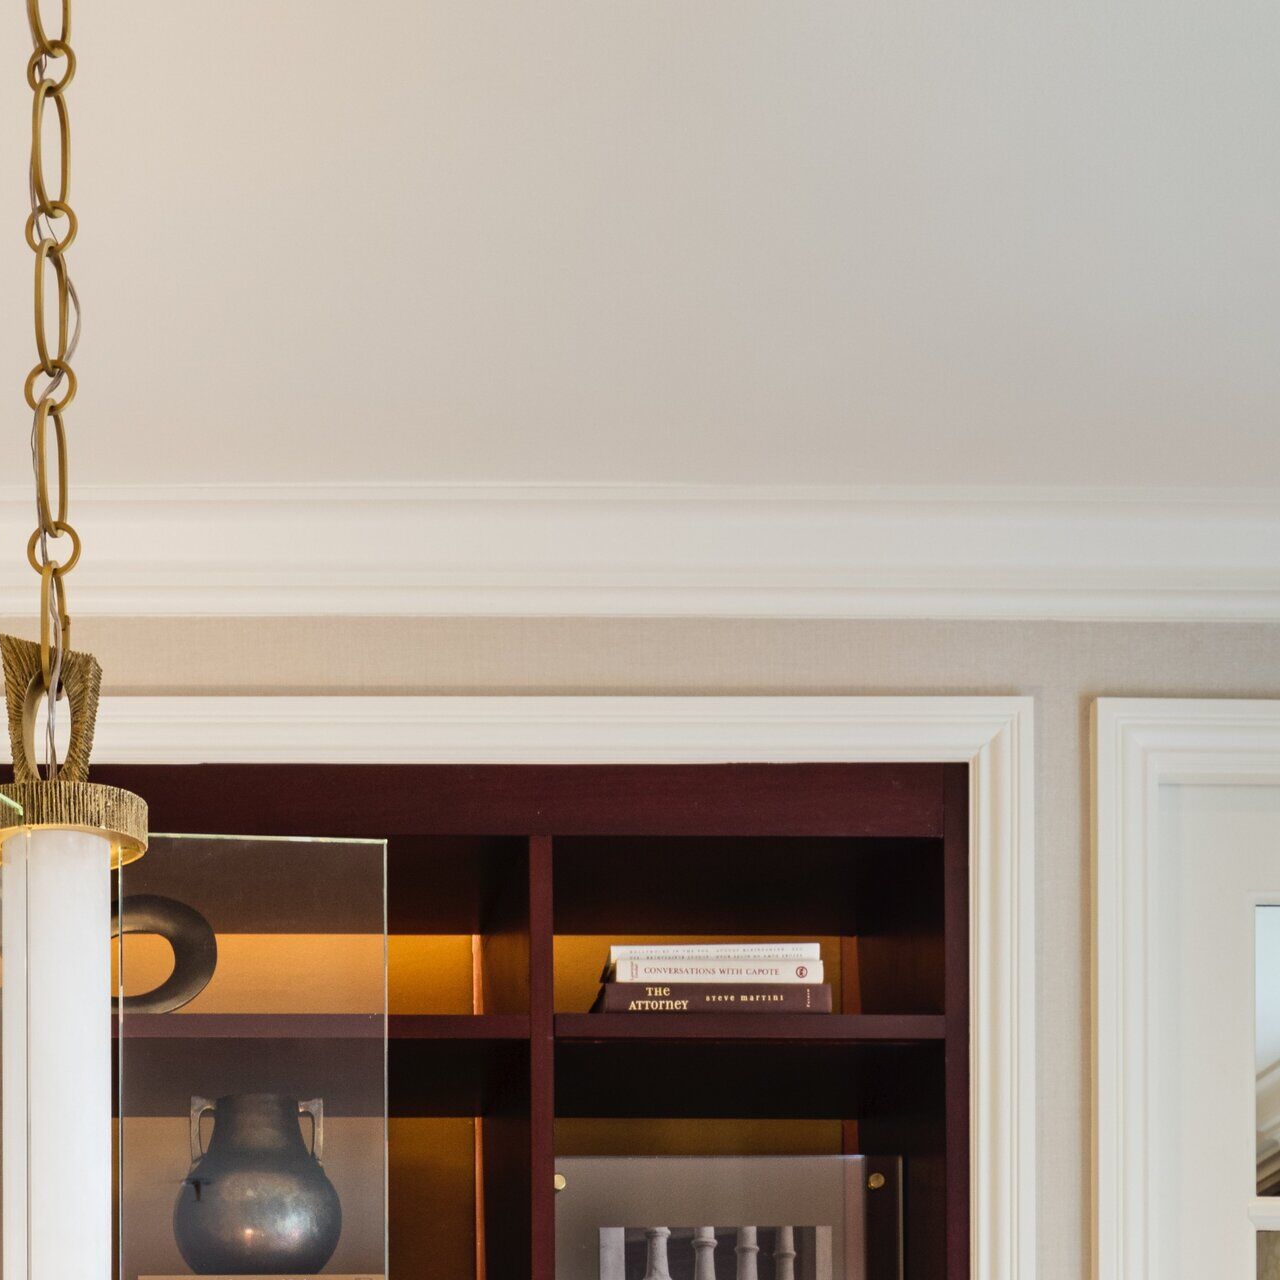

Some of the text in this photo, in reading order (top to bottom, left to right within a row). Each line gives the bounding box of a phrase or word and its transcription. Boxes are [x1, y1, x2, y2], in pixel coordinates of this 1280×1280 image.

[644, 967, 717, 976] CONVERSATIONS
[719, 967, 742, 976] WITH
[746, 967, 781, 977] CAPOTE
